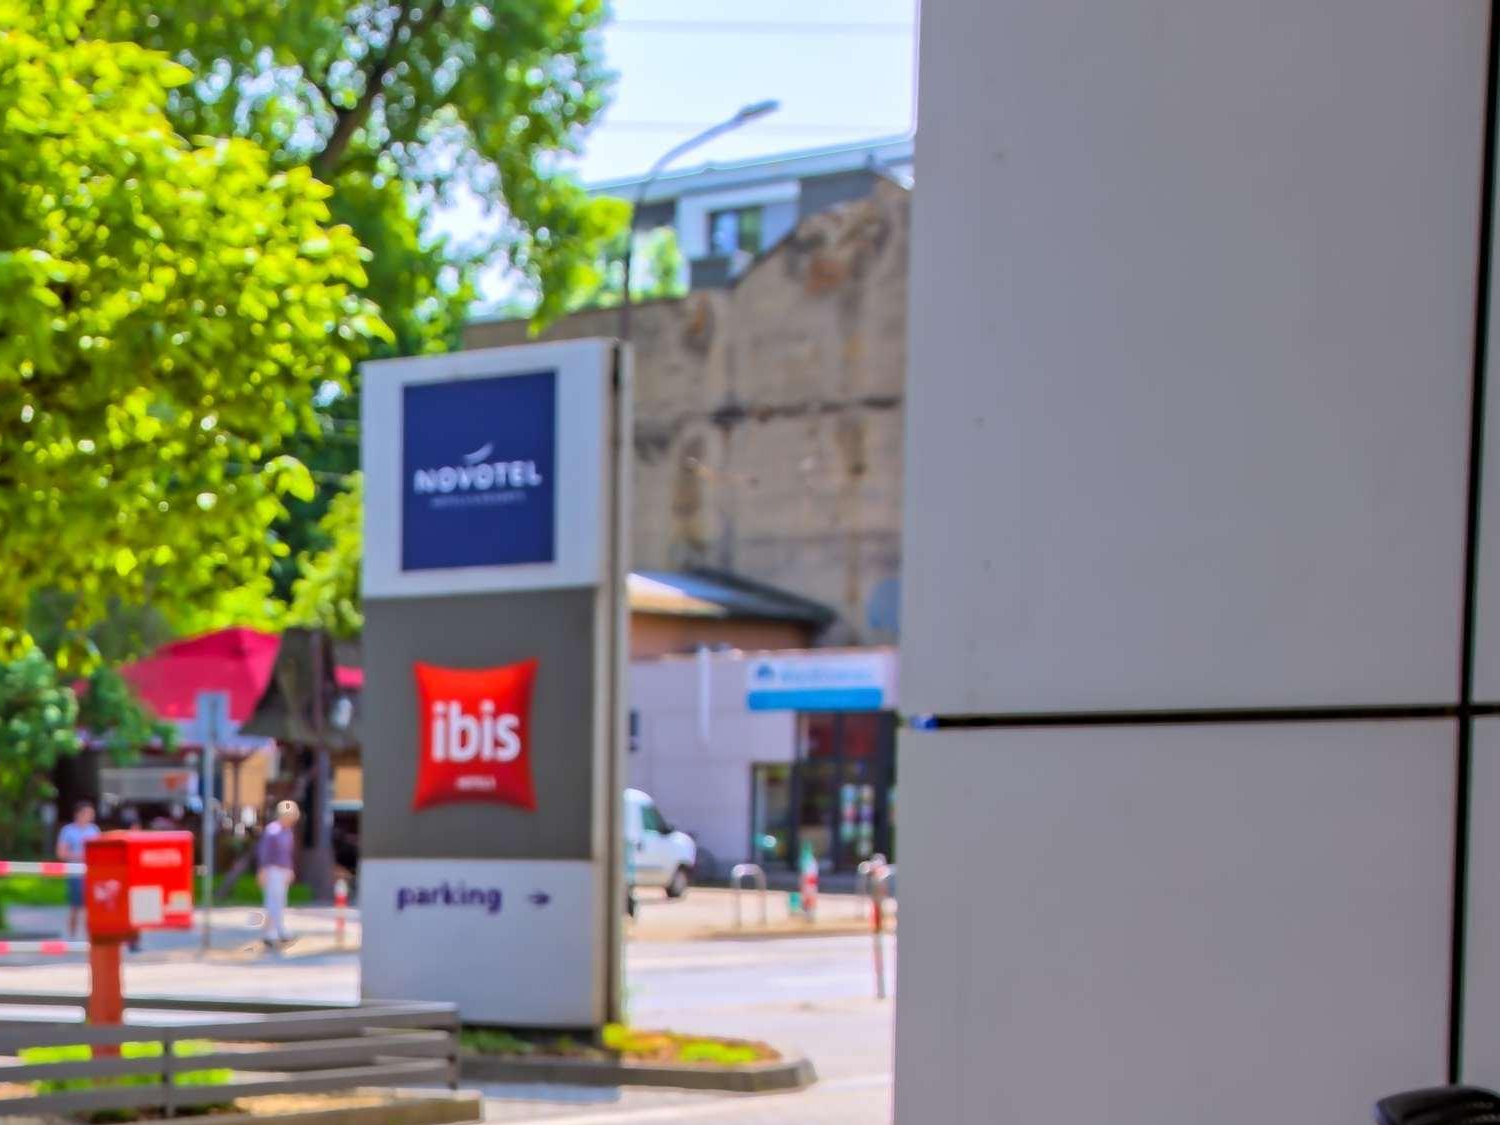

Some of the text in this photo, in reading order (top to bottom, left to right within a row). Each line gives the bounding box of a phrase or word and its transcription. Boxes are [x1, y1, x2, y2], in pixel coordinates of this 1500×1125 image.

[413, 460, 543, 494] NOVOTEL
[431, 699, 521, 763] ibis
[396, 879, 503, 916] parking
